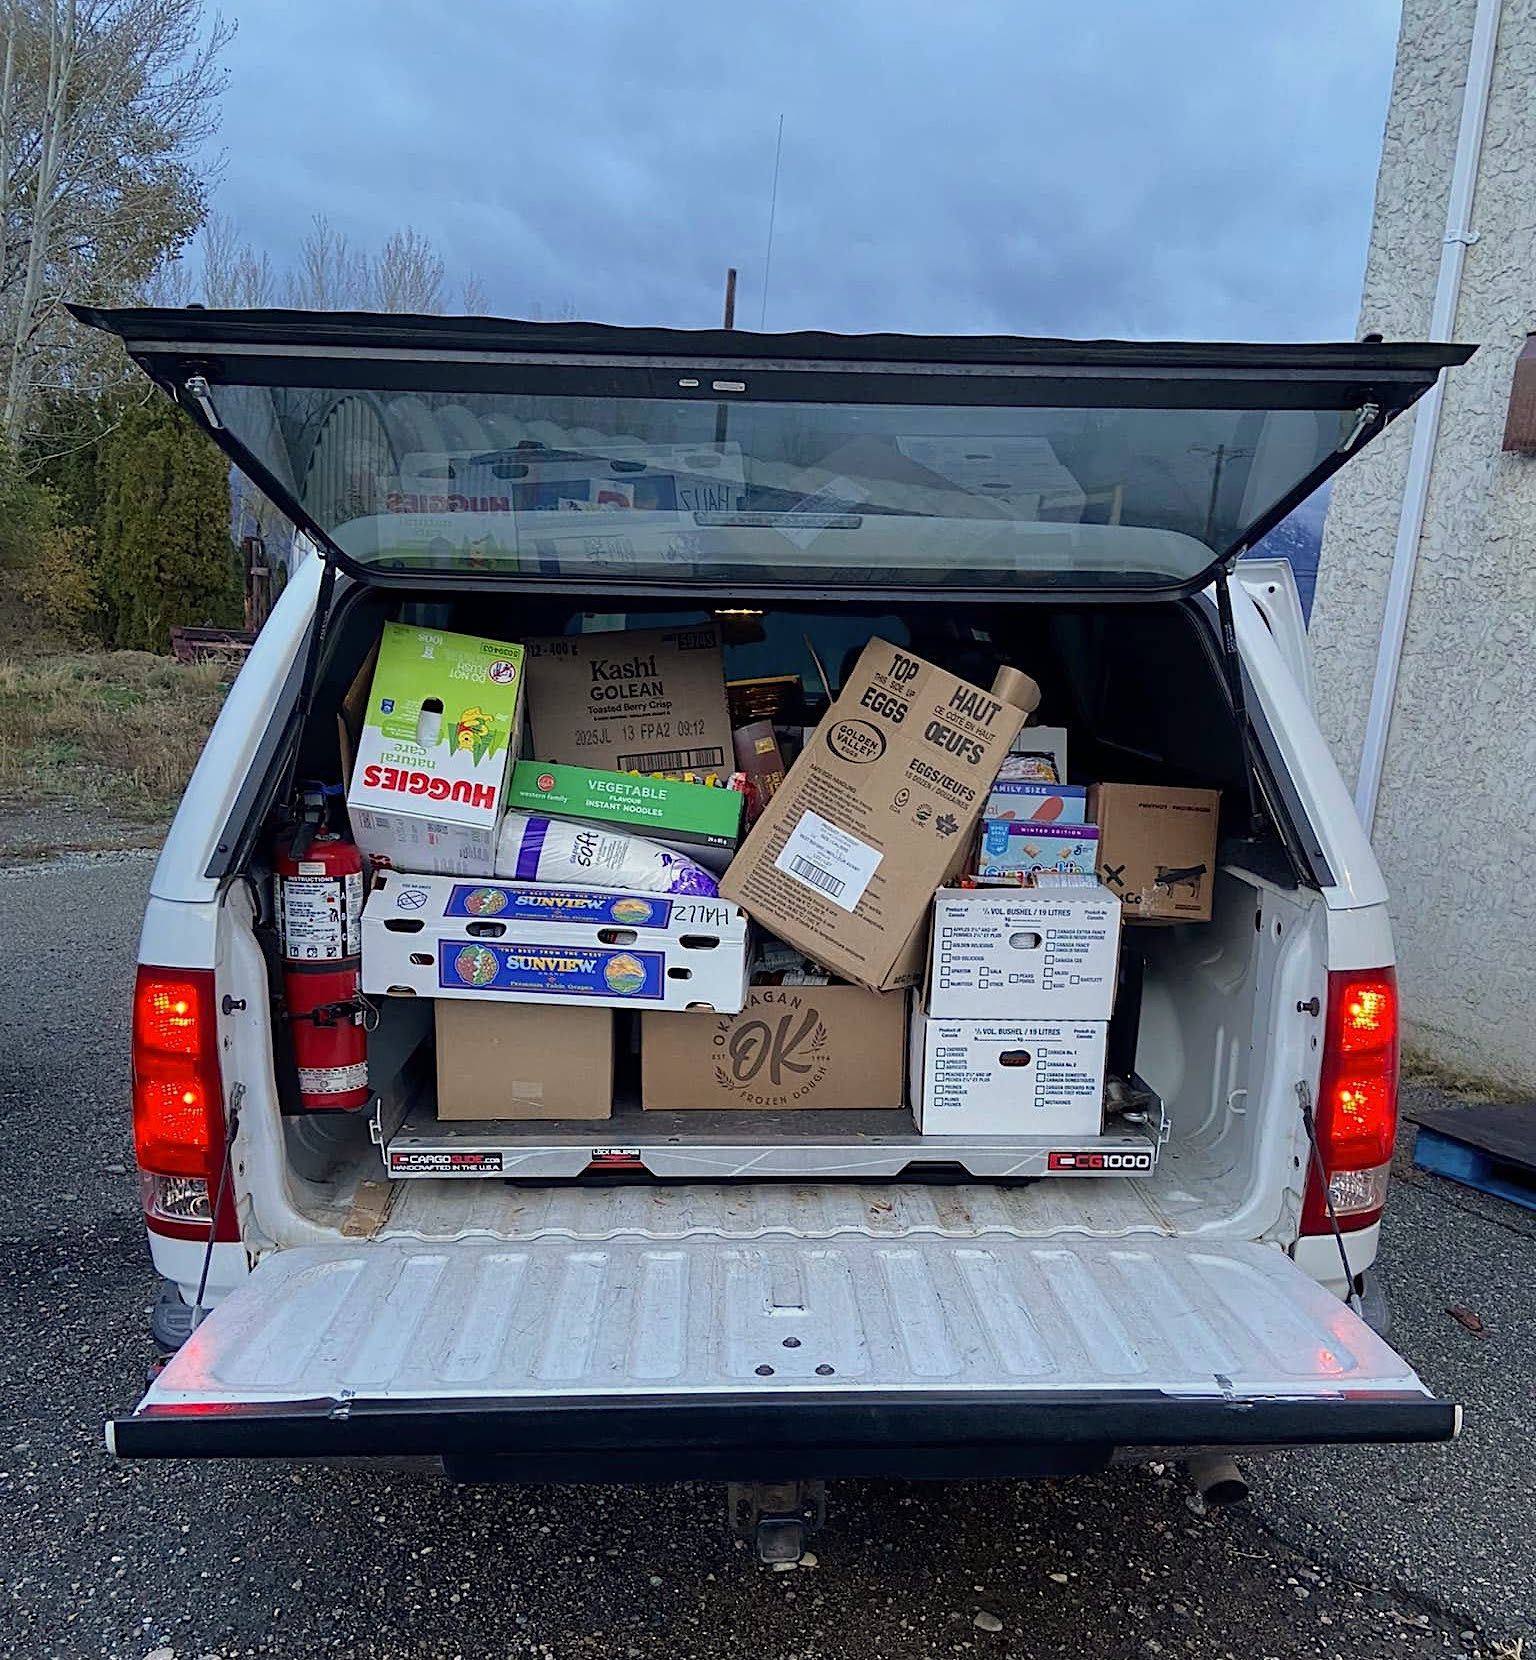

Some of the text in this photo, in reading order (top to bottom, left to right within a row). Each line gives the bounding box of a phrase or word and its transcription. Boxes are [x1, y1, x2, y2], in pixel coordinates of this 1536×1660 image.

[448, 669, 486, 683] DO NOT
[590, 654, 658, 682] Kashi
[889, 653, 920, 683] TOP
[590, 681, 664, 701] GOLEAN
[905, 688, 916, 699] UP
[587, 700, 672, 715] Toasted Berry Crisp
[860, 686, 909, 724] EGGS
[950, 685, 1002, 727] HAUT
[575, 728, 612, 746] 2025JL
[622, 725, 635, 741] 13
[678, 719, 705, 737] 09:12
[933, 704, 945, 715] CE
[964, 720, 976, 731] EN
[975, 726, 995, 742] HAUT
[835, 732, 874, 757] VALLEY
[838, 724, 878, 750] GOLDEN
[922, 718, 986, 765] ŒUFS
[393, 743, 428, 756] care
[381, 752, 436, 770] natural
[363, 765, 496, 810] HUGGIES
[588, 779, 668, 800] VEGETABLE
[911, 775, 932, 789] DOZEN
[935, 787, 969, 809] DOUZAINES
[991, 785, 1047, 794] AMILY SIZE
[520, 791, 568, 804] western family
[609, 795, 642, 804] FLAVOUR
[586, 799, 663, 816] INSTANT NOODLES
[577, 831, 599, 867] soft
[341, 892, 346, 900] A
[515, 896, 606, 910] SUNVIEW
[341, 912, 346, 921] B
[1006, 908, 1032, 916] BUSHEL
[1033, 908, 1038, 916] /
[1048, 909, 1071, 917] LITRES
[342, 933, 347, 941] C
[506, 955, 597, 974] SUNVIEW
[998, 1028, 1023, 1036] BUSHEL
[1024, 1028, 1028, 1036] /
[1038, 1028, 1061, 1036] LITRES
[729, 1009, 819, 1085] OK
[739, 1066, 826, 1106] FROZEN DOUGH
